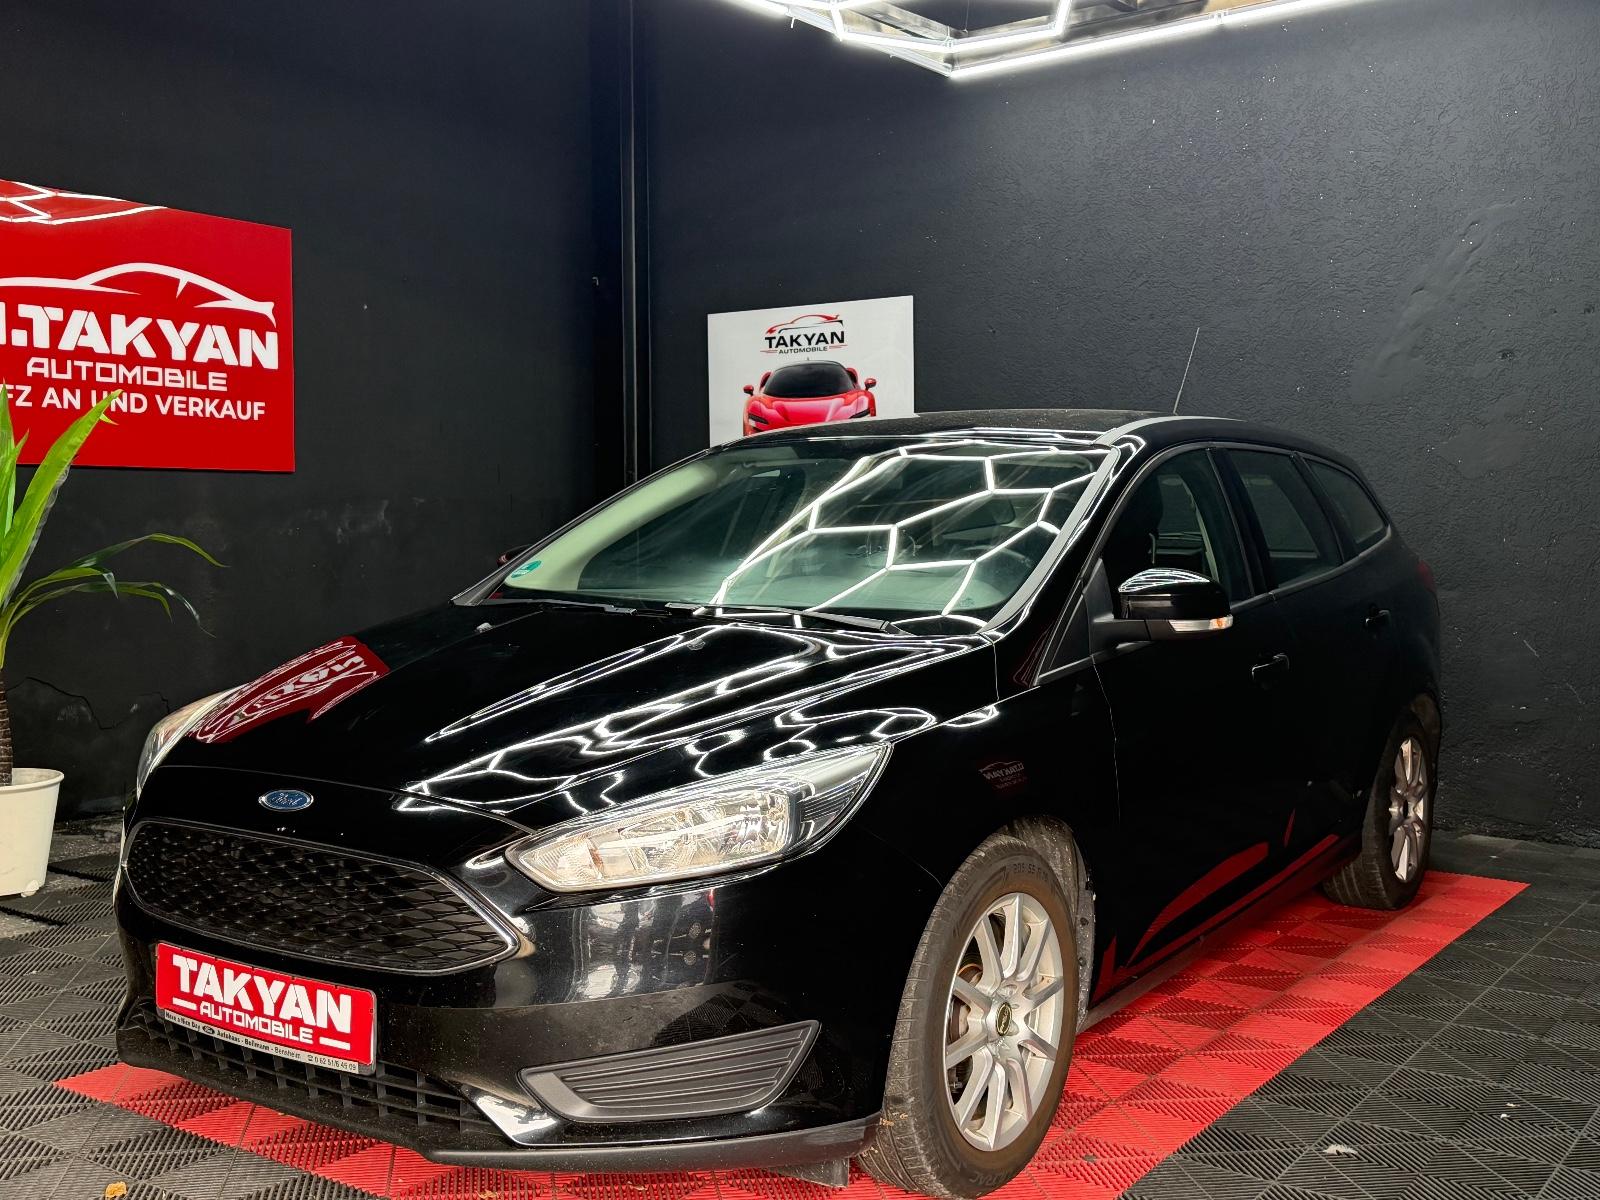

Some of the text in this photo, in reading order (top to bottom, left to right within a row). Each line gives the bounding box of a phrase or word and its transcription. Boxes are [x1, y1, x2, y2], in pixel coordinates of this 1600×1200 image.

[764, 331, 845, 349] TAKYAN
[778, 346, 828, 354] AUTOMOBILE
[26, 356, 228, 392] AUTOMOBILE
[41, 387, 81, 410] AN
[155, 394, 266, 420] VERKAUF
[172, 954, 352, 1034] TAKYAN
[200, 1000, 314, 1044] AUTOMOBILE
[217, 1030, 241, 1043] Autohaus
